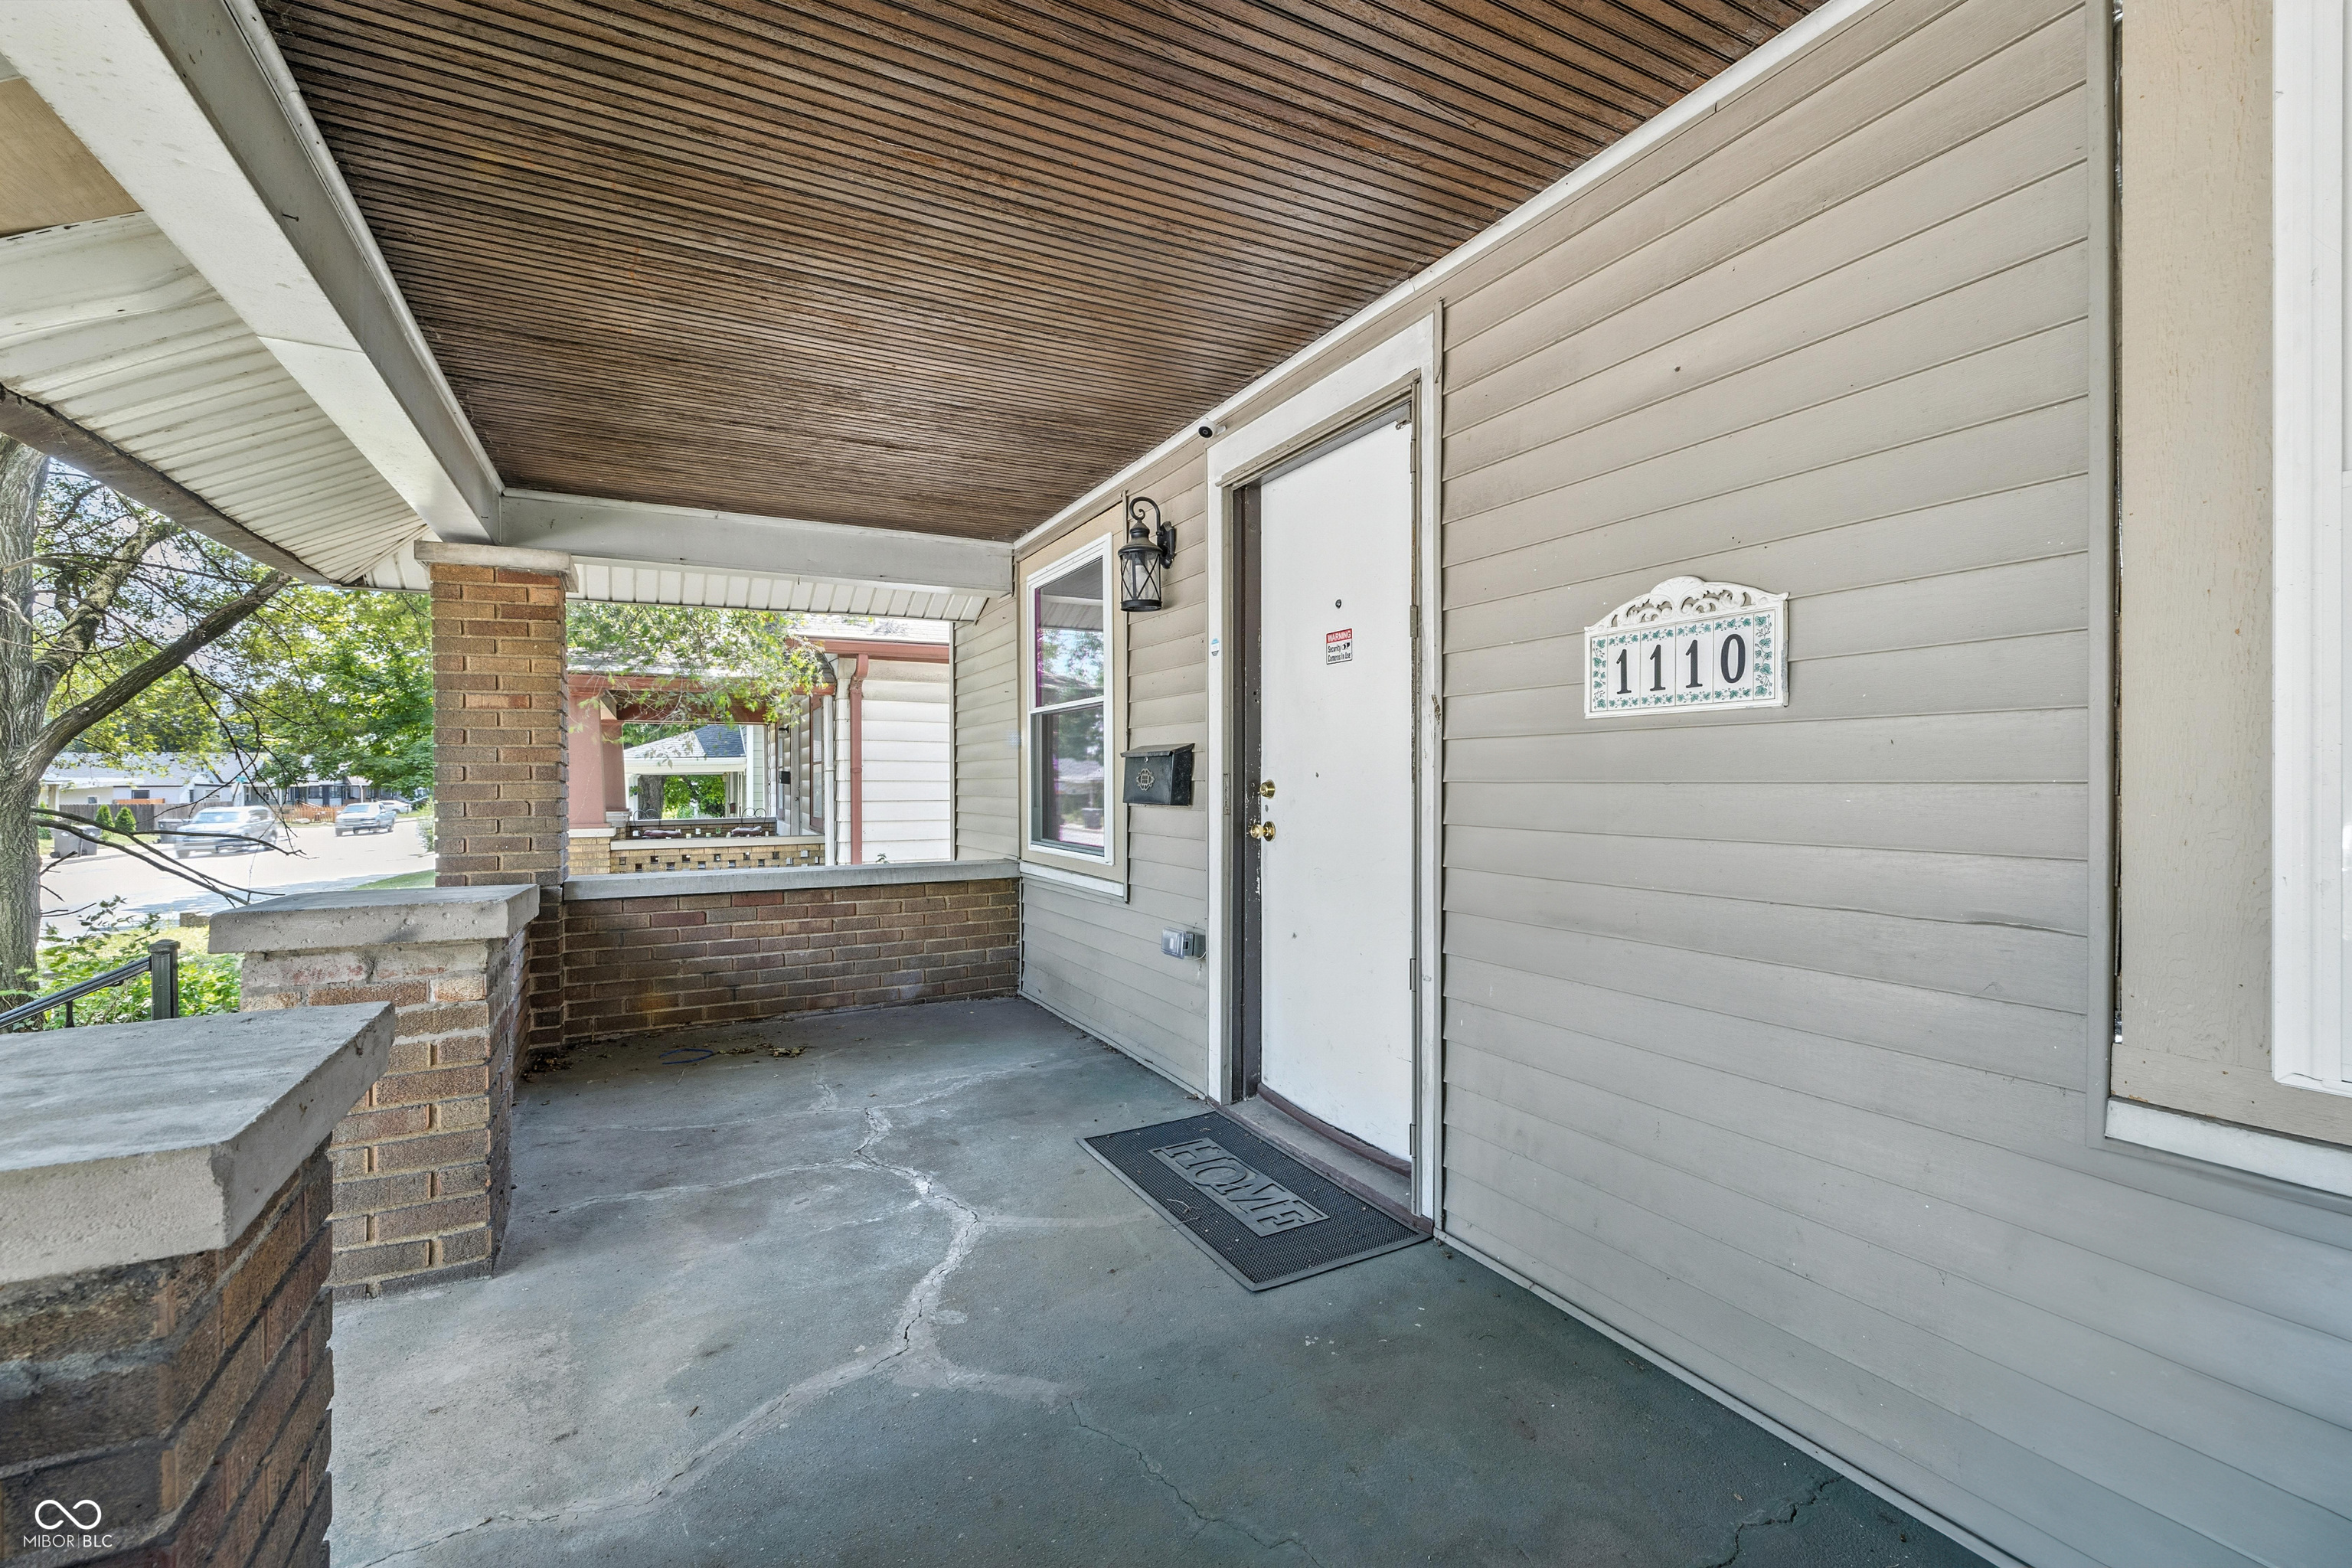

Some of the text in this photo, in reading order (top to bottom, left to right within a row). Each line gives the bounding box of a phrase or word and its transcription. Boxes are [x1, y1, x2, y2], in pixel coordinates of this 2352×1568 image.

[1327, 630, 1351, 642] WARNING
[1328, 644, 1341, 653] Security
[1615, 633, 1746, 695] 1110
[1155, 1140, 1321, 1232] HOME
